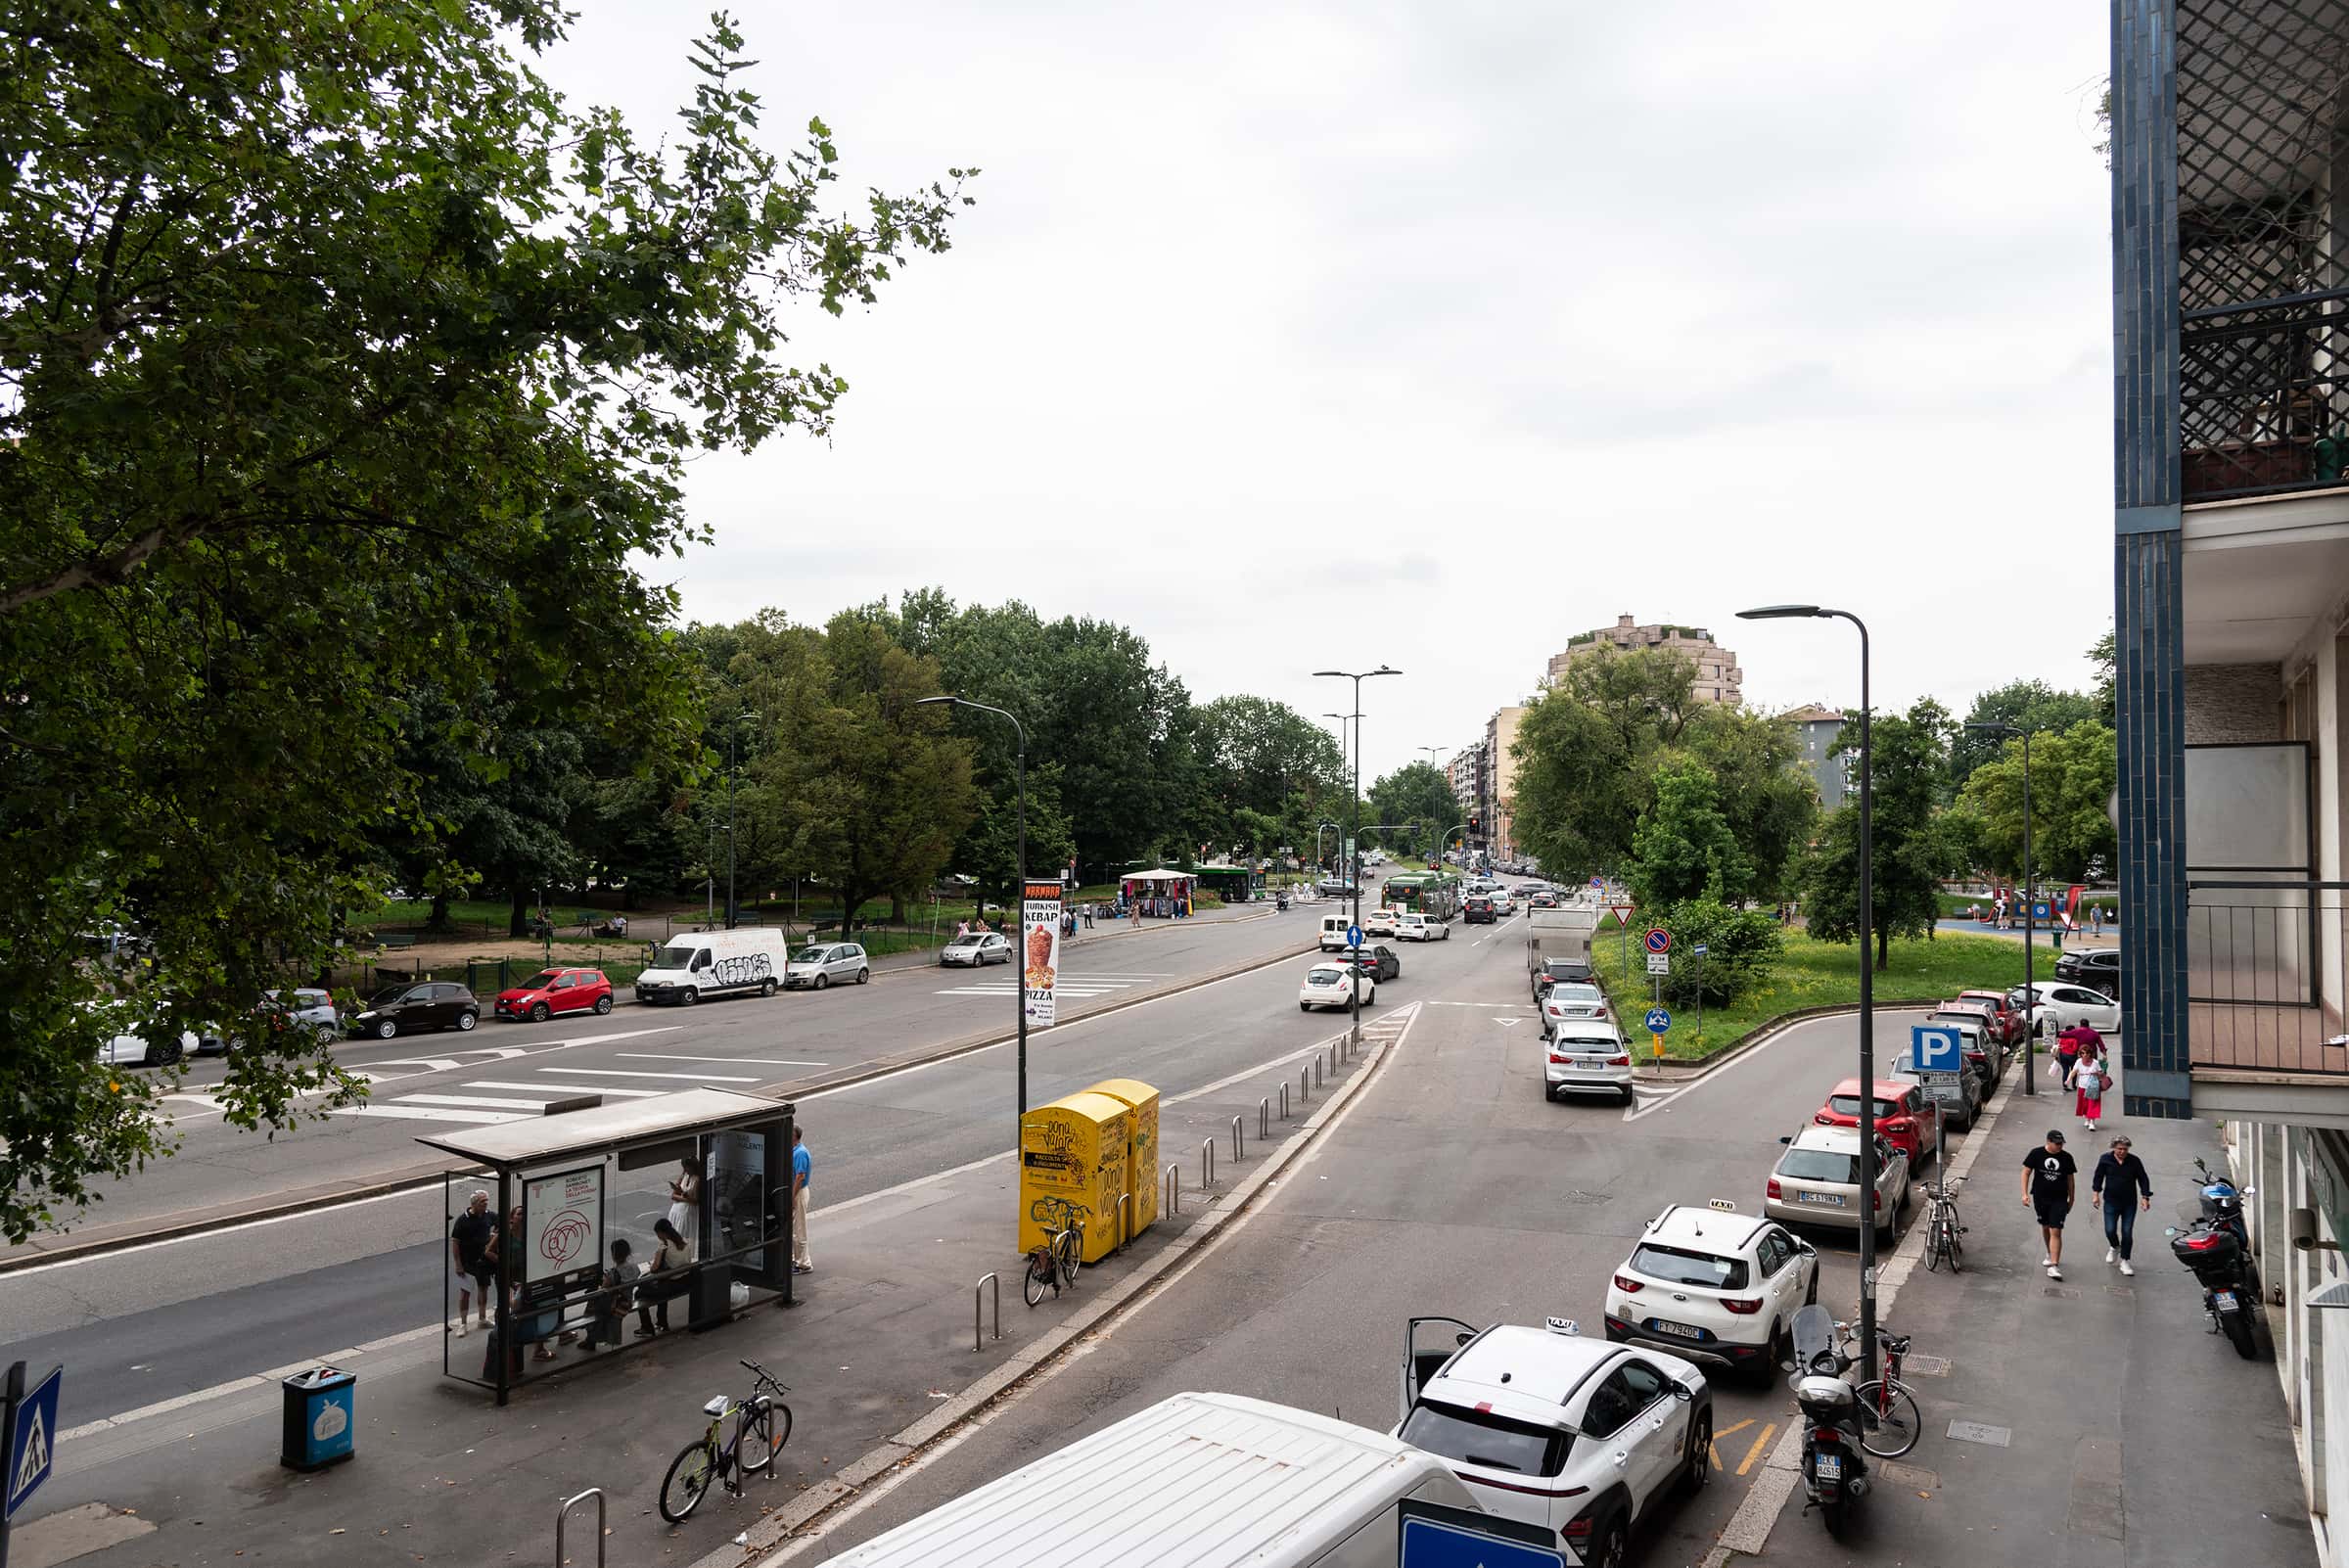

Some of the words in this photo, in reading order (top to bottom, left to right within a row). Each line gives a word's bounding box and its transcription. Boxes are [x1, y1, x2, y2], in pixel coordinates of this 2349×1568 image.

[1026, 911, 1058, 922] KEBAP
[1026, 990, 1052, 1000] PIZZA
[1921, 1032, 1952, 1066] P
[1711, 1200, 1733, 1209] TAXI
[1549, 1317, 1573, 1328] TAXI
[1660, 1321, 1670, 1331] FY
